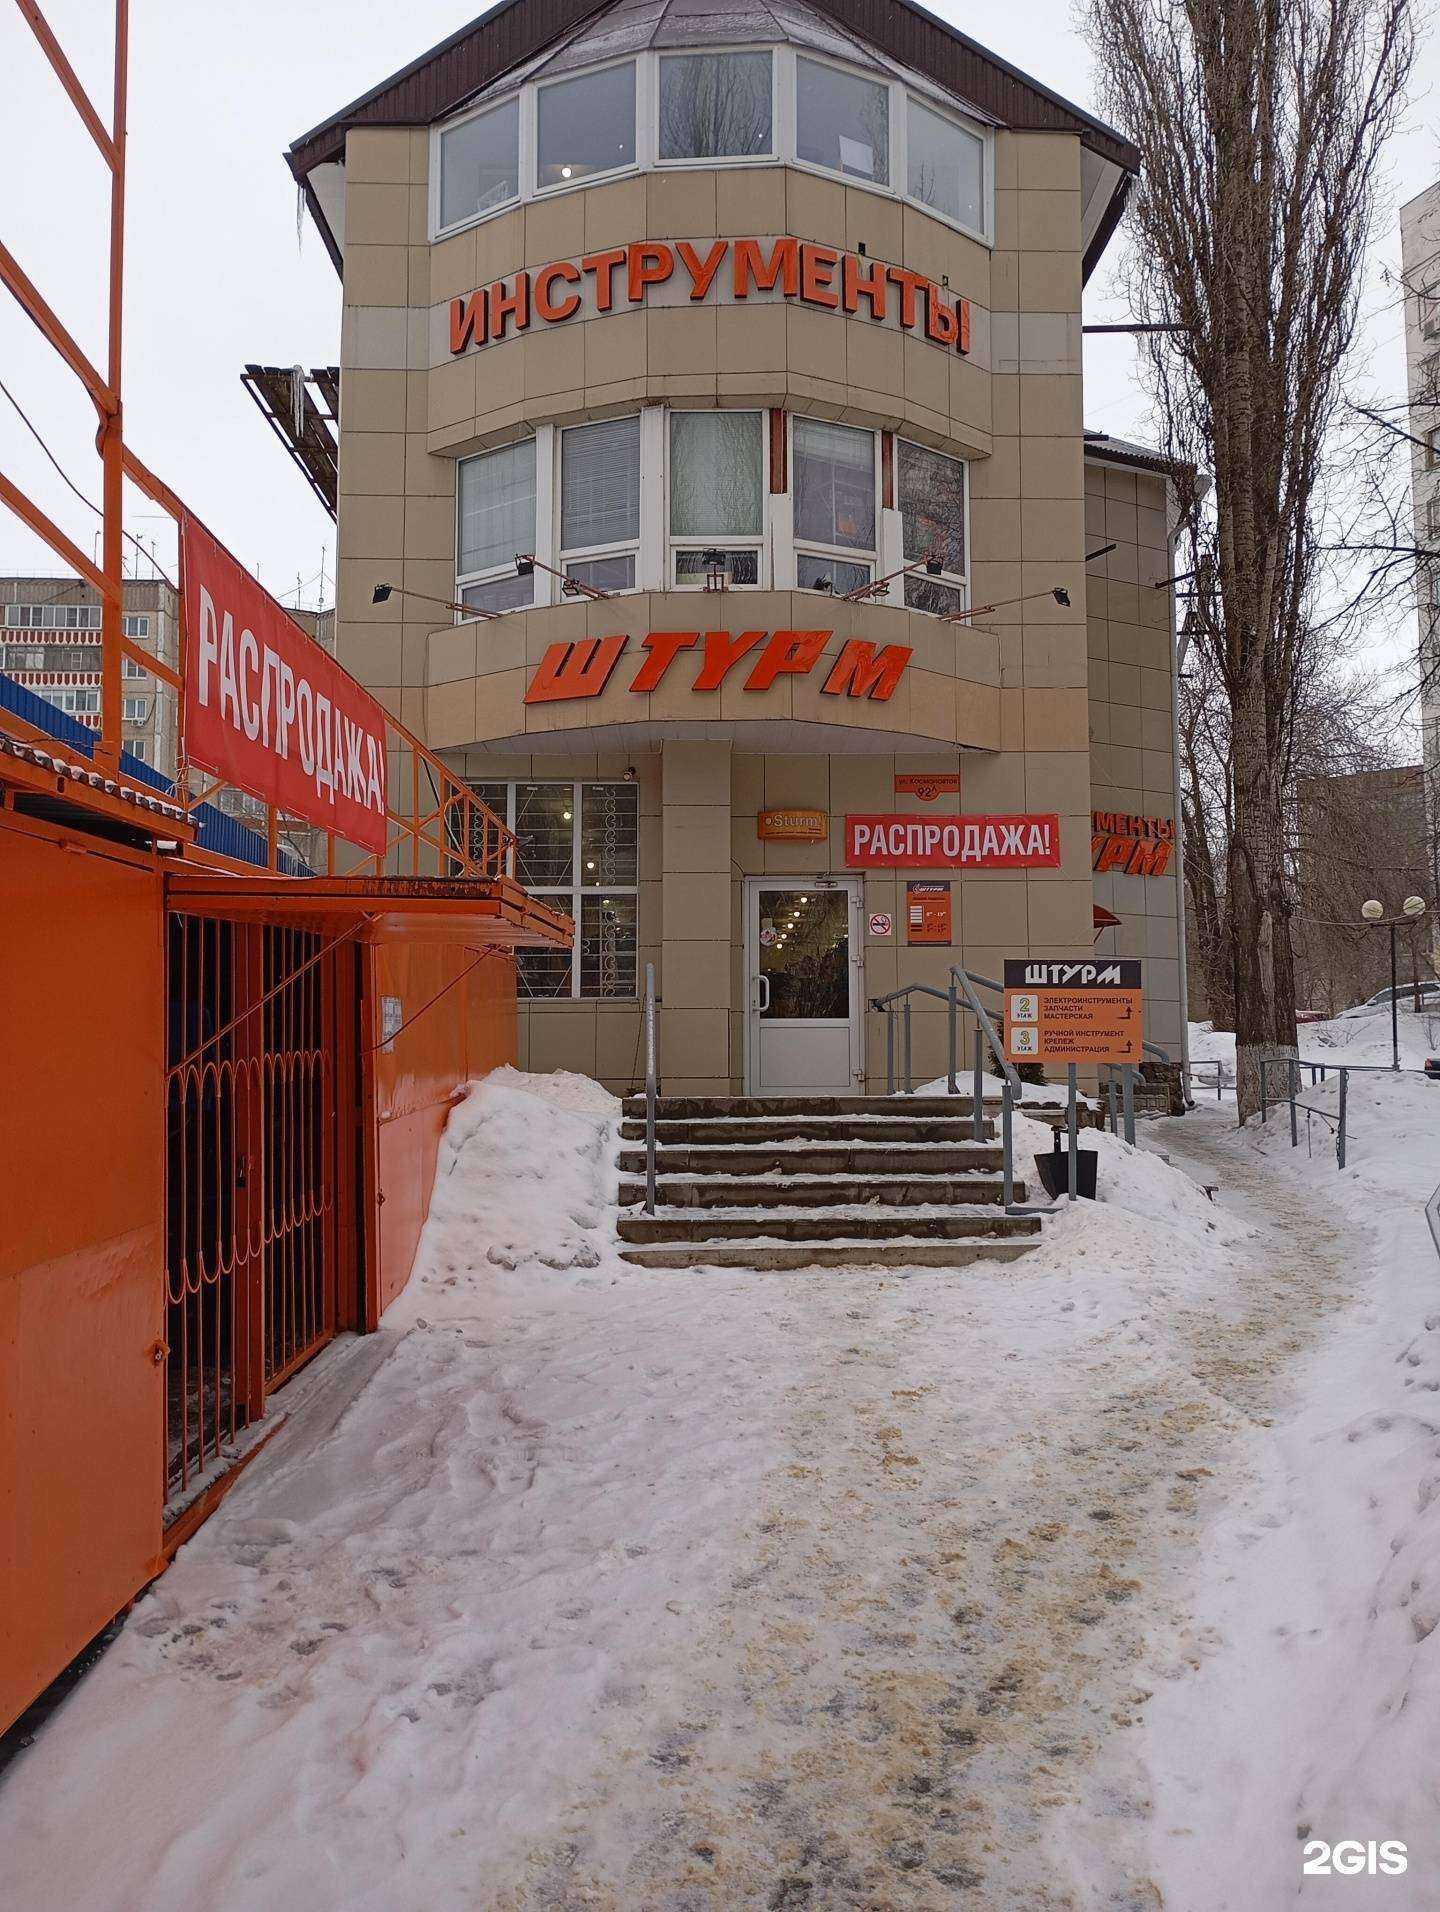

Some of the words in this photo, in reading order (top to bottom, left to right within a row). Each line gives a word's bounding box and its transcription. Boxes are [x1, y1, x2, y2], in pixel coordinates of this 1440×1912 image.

[449, 238, 971, 355] ИНСТРУМЕНТЫ
[523, 629, 914, 704] ШТУРМ
[199, 583, 385, 816] РАСПРОДАЖА!
[854, 824, 1050, 862] РАСПРОДАЖА!
[1025, 964, 1121, 984] ШТУРМ
[1019, 997, 1030, 1012] 2
[1019, 1030, 1030, 1045] 3
[1044, 1029, 1073, 1037] РУЧНОЙ
